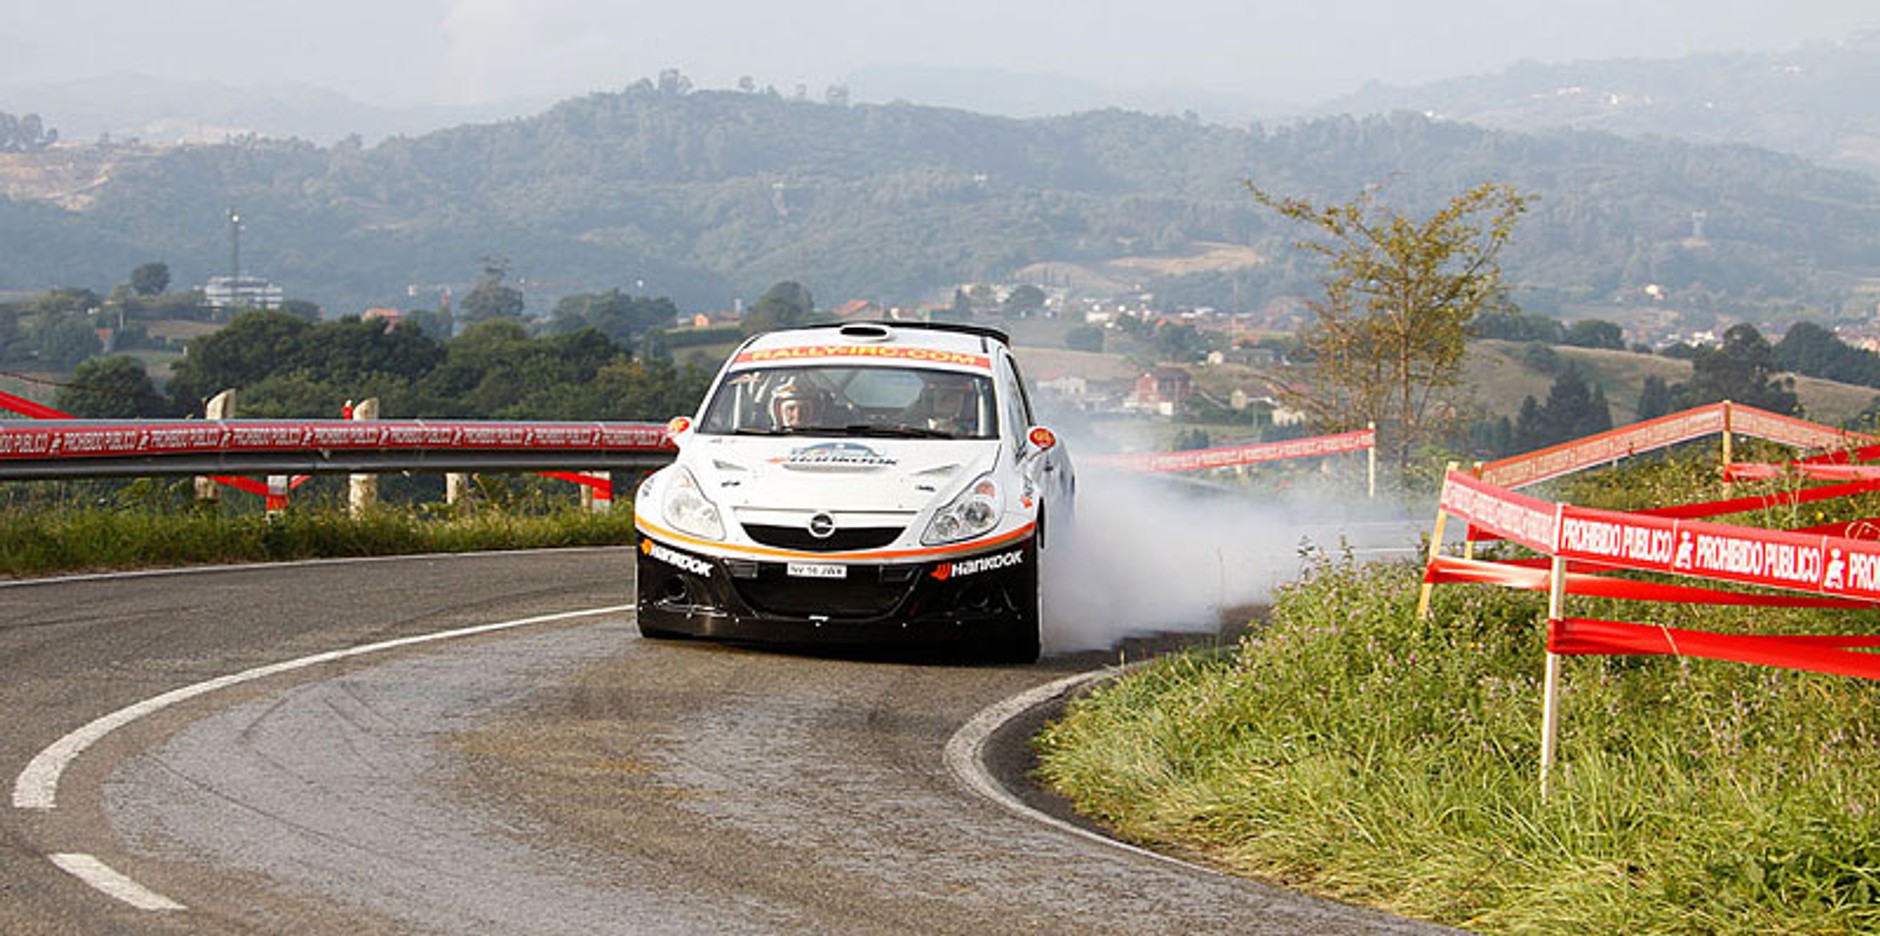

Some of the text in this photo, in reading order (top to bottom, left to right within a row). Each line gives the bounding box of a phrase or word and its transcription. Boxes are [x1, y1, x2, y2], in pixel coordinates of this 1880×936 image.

[1561, 517, 1620, 556] PROHIBIDO
[1621, 525, 1672, 563] PUBLICO
[1696, 534, 1763, 575] PROHIBIDO
[1763, 543, 1820, 583] PUBLICO
